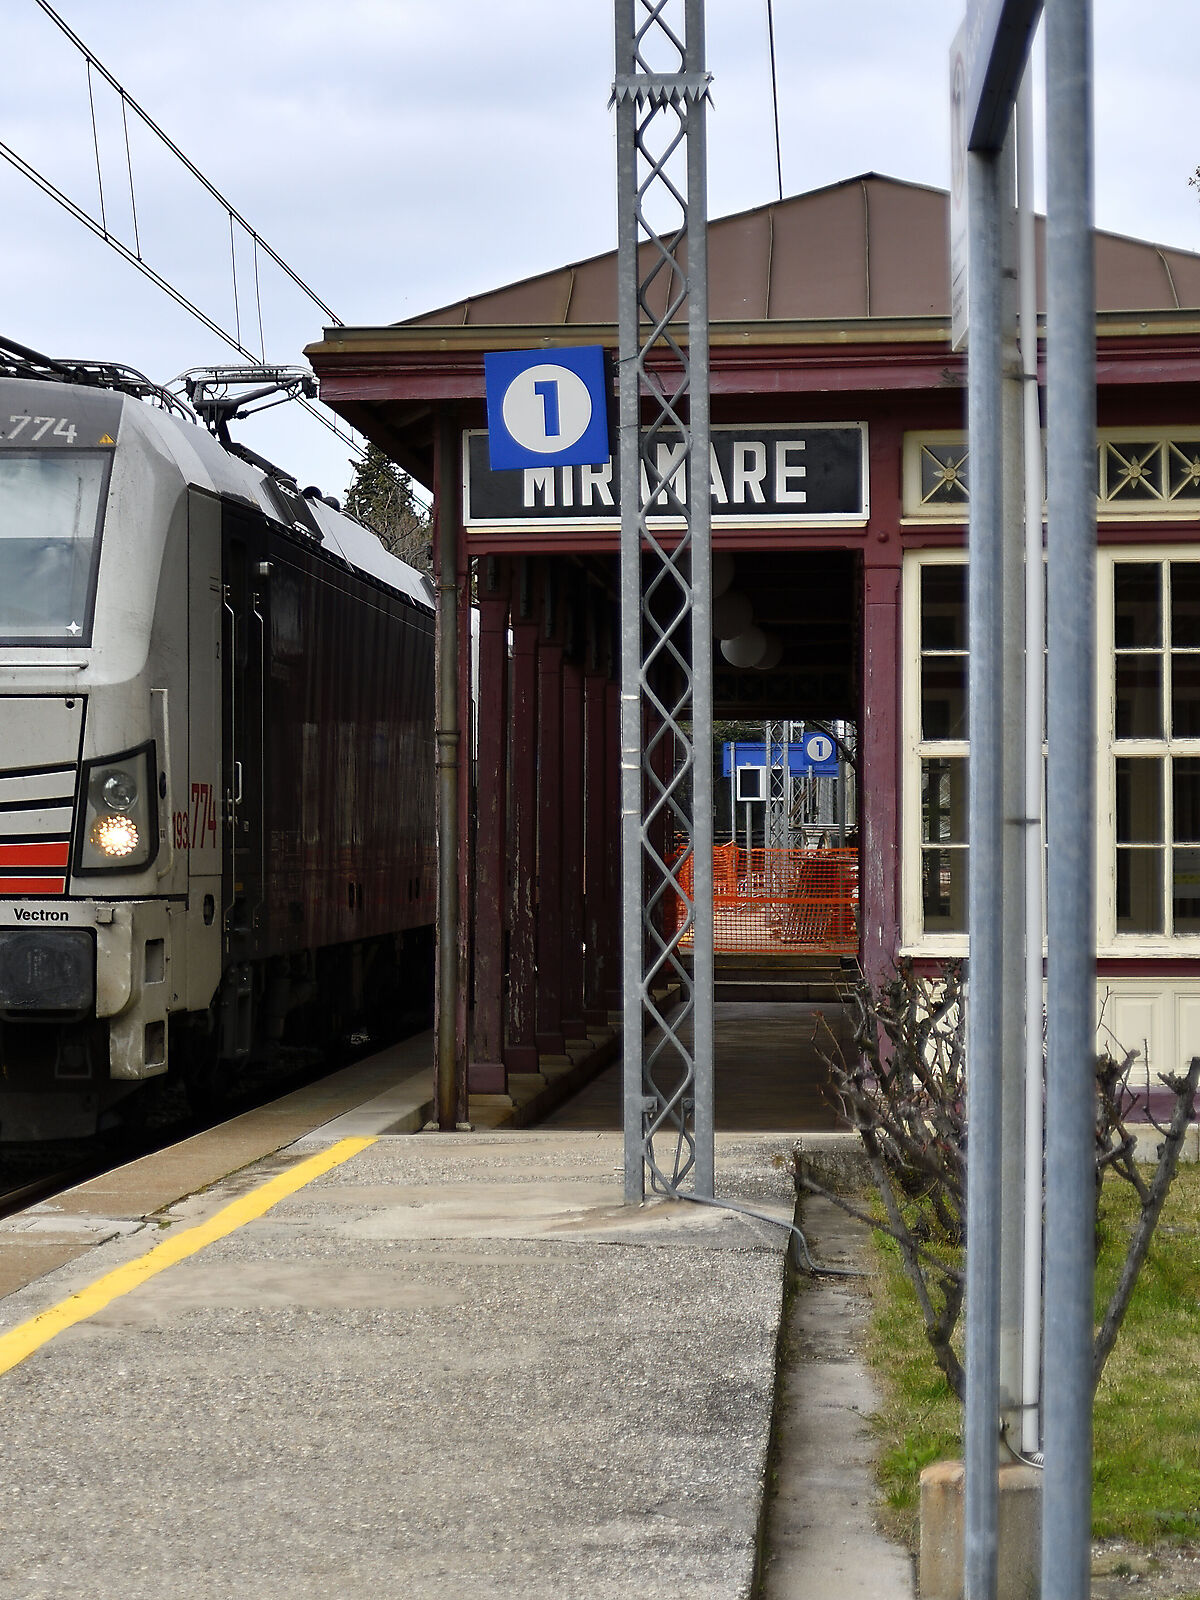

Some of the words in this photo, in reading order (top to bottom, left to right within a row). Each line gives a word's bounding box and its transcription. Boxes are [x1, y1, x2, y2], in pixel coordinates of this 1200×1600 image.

[534, 380, 561, 437] 1
[523, 441, 807, 507] MIRMRE
[816, 741, 824, 757] 1
[13, 907, 69, 921] Vectron
